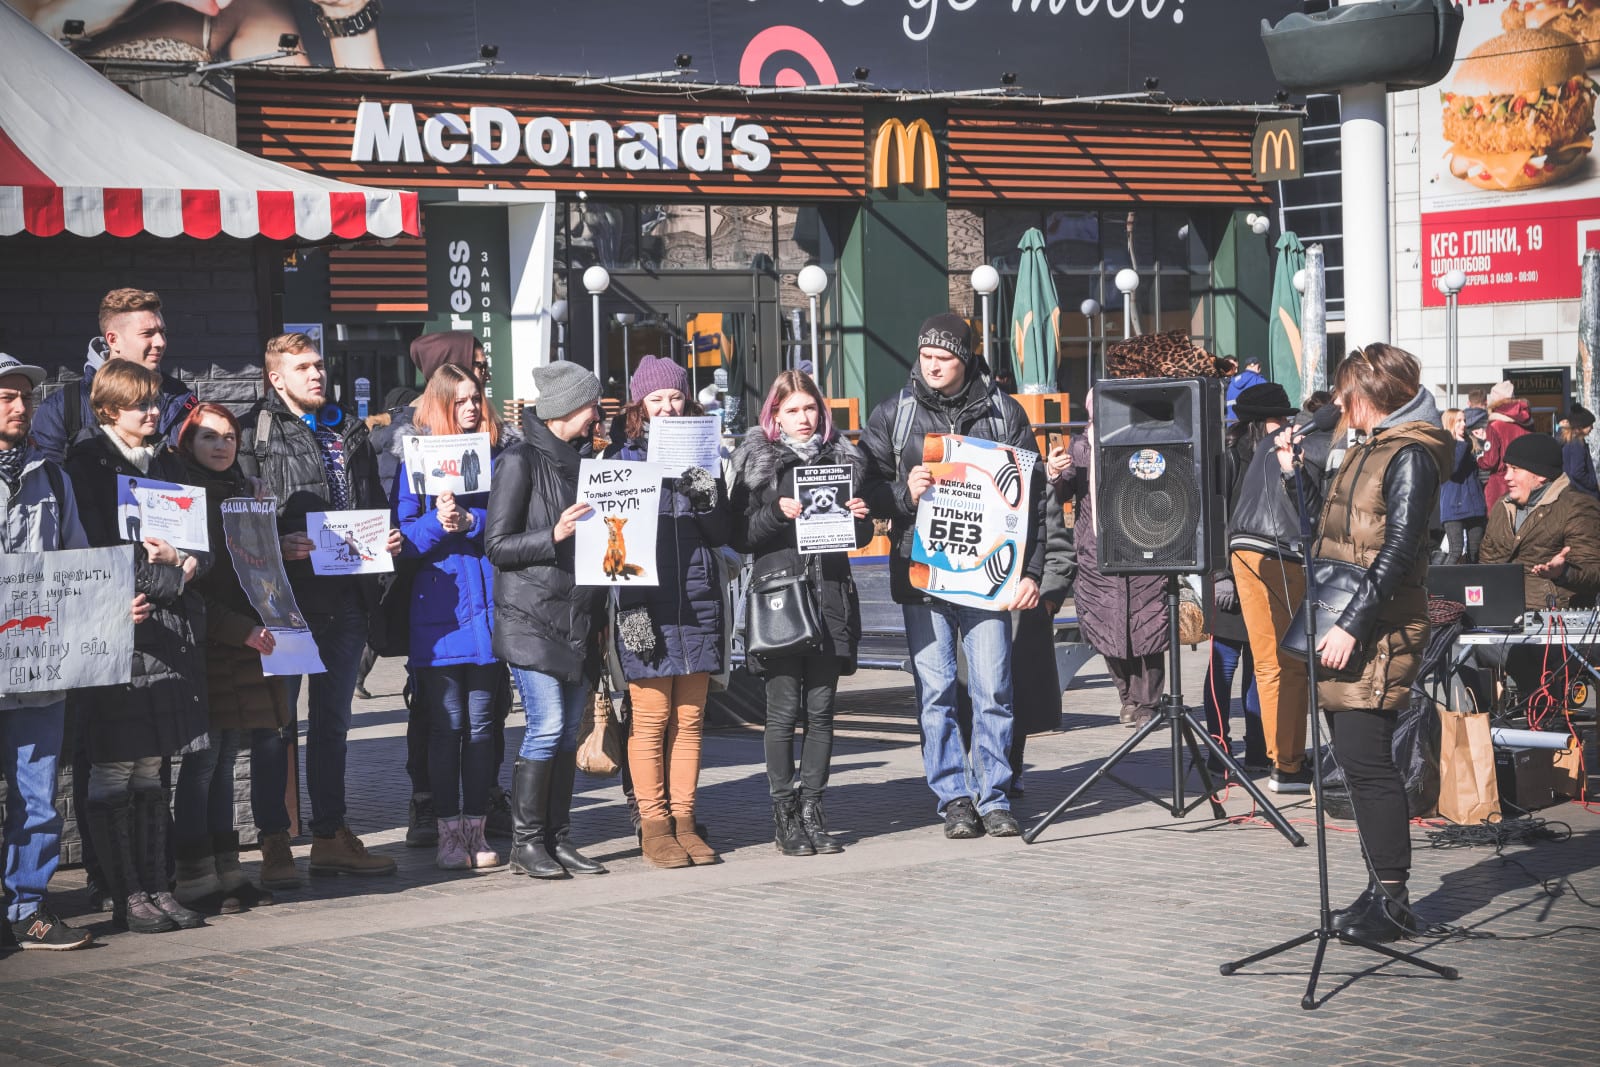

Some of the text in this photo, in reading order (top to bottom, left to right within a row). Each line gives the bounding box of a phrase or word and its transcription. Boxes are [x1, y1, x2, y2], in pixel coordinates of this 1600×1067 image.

[350, 101, 772, 172] McDonald's
[1430, 225, 1543, 257] KFC ГЛІНКИ, 19
[1431, 255, 1491, 276] ЦІЛОДОБОВО
[449, 240, 473, 330] ress
[1465, 273, 1489, 286] ЕРЕРВА
[480, 251, 493, 398] ЗАМОВЛЯЙЕ
[589, 468, 632, 485] МЕХ?
[820, 467, 844, 475] ЖИЗНЬ
[584, 486, 656, 499] Только через мой
[939, 487, 981, 500] ЯК ХОЧЕШ
[940, 478, 982, 492] ВДЯГАЙСЯ
[221, 501, 275, 515] ВАША МОДА
[597, 497, 640, 513] ТРУП!
[932, 506, 983, 523] ТІЛЬКИ
[929, 519, 983, 545] БЕЗ
[928, 539, 979, 558] ХУТРА
[27, 920, 53, 939] N
